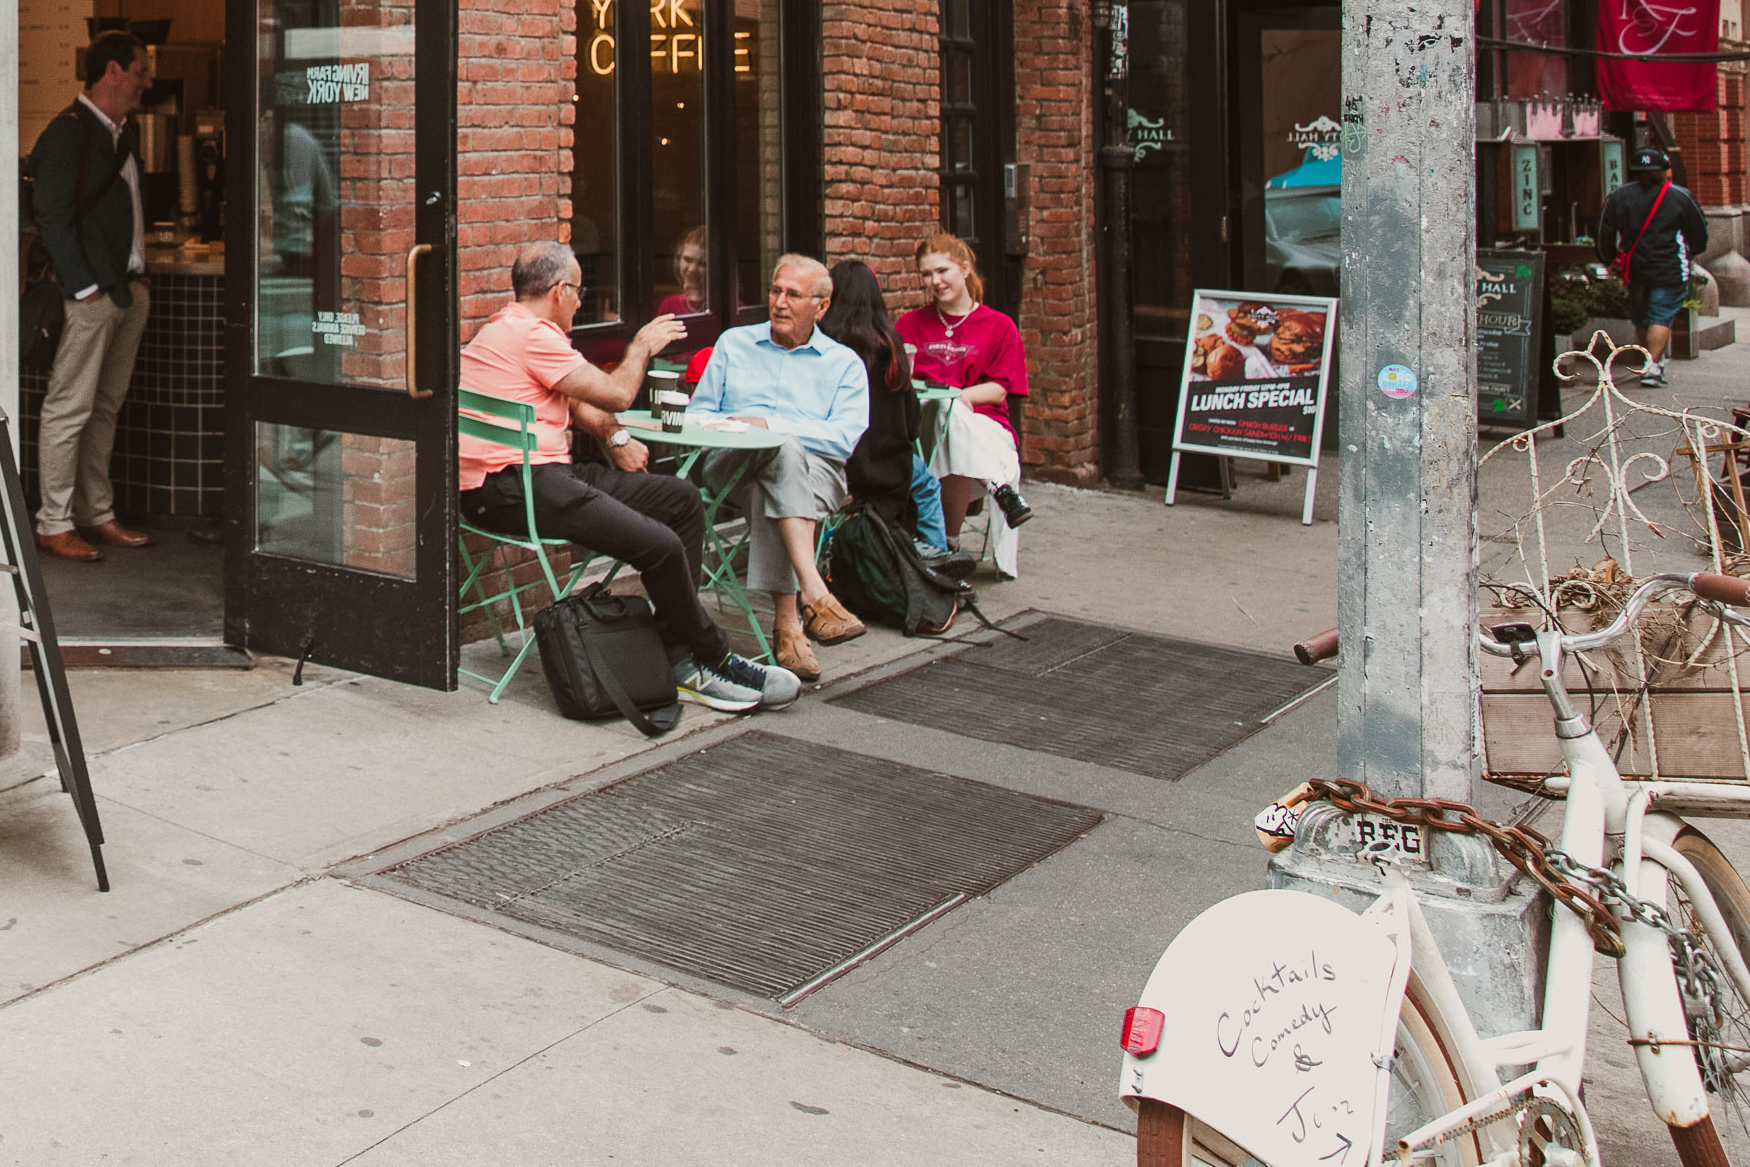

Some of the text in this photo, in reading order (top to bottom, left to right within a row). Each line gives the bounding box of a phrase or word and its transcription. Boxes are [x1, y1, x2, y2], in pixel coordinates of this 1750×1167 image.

[1137, 129, 1175, 141] HALL
[1521, 159, 1533, 217] ZINC
[1481, 282, 1517, 294] HALL
[1190, 388, 1315, 412] LUNCH SPECIAL
[1216, 949, 1337, 1058] Cocktails
[1251, 1002, 1338, 1068] Comedy
